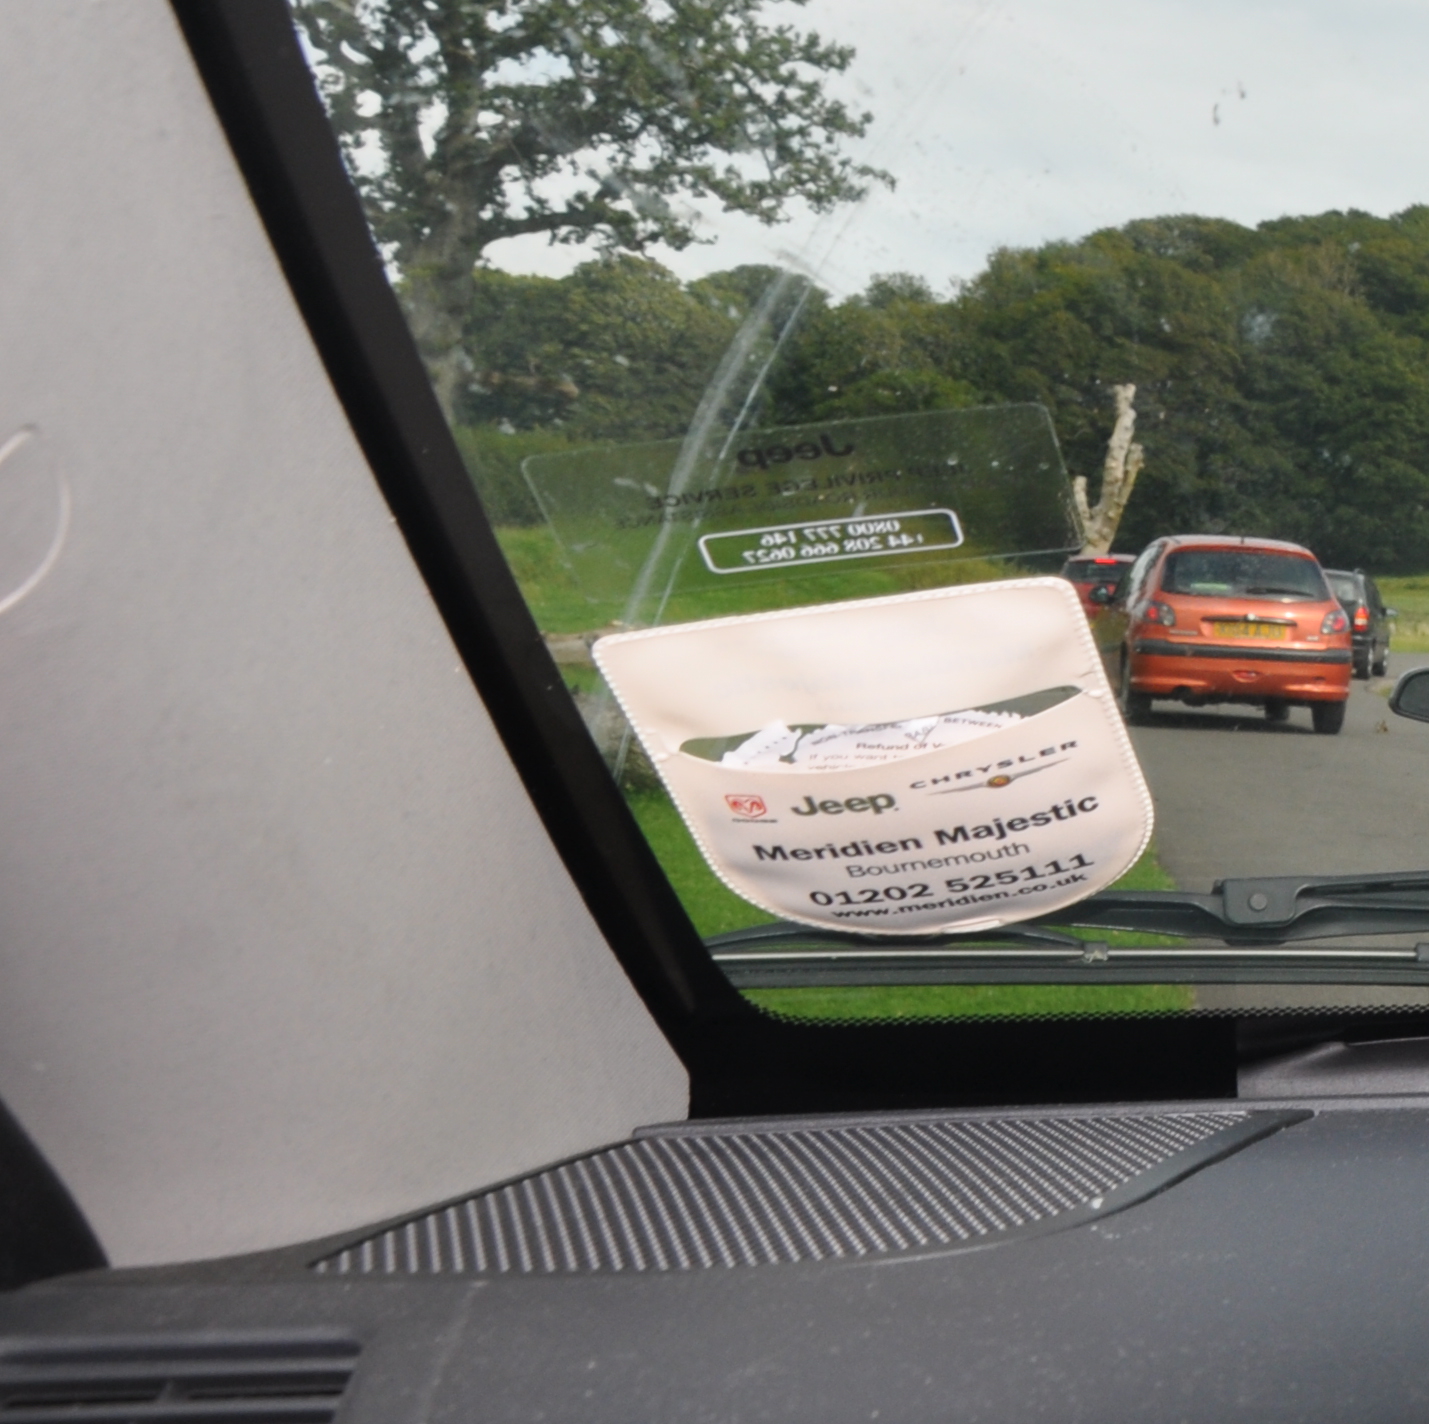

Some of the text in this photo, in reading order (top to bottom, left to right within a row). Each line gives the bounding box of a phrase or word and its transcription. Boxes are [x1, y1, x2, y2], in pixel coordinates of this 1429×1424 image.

[856, 742, 909, 751] Refund
[913, 742, 928, 751] of
[909, 740, 1078, 789] CHRYSLER
[791, 791, 896, 817] Jeep
[753, 795, 1100, 862] Meridien Majestic
[808, 853, 1095, 907] 01202 525111
[845, 840, 1031, 879] Bournemouth
[831, 872, 1089, 918] www.meridien.co.uk
